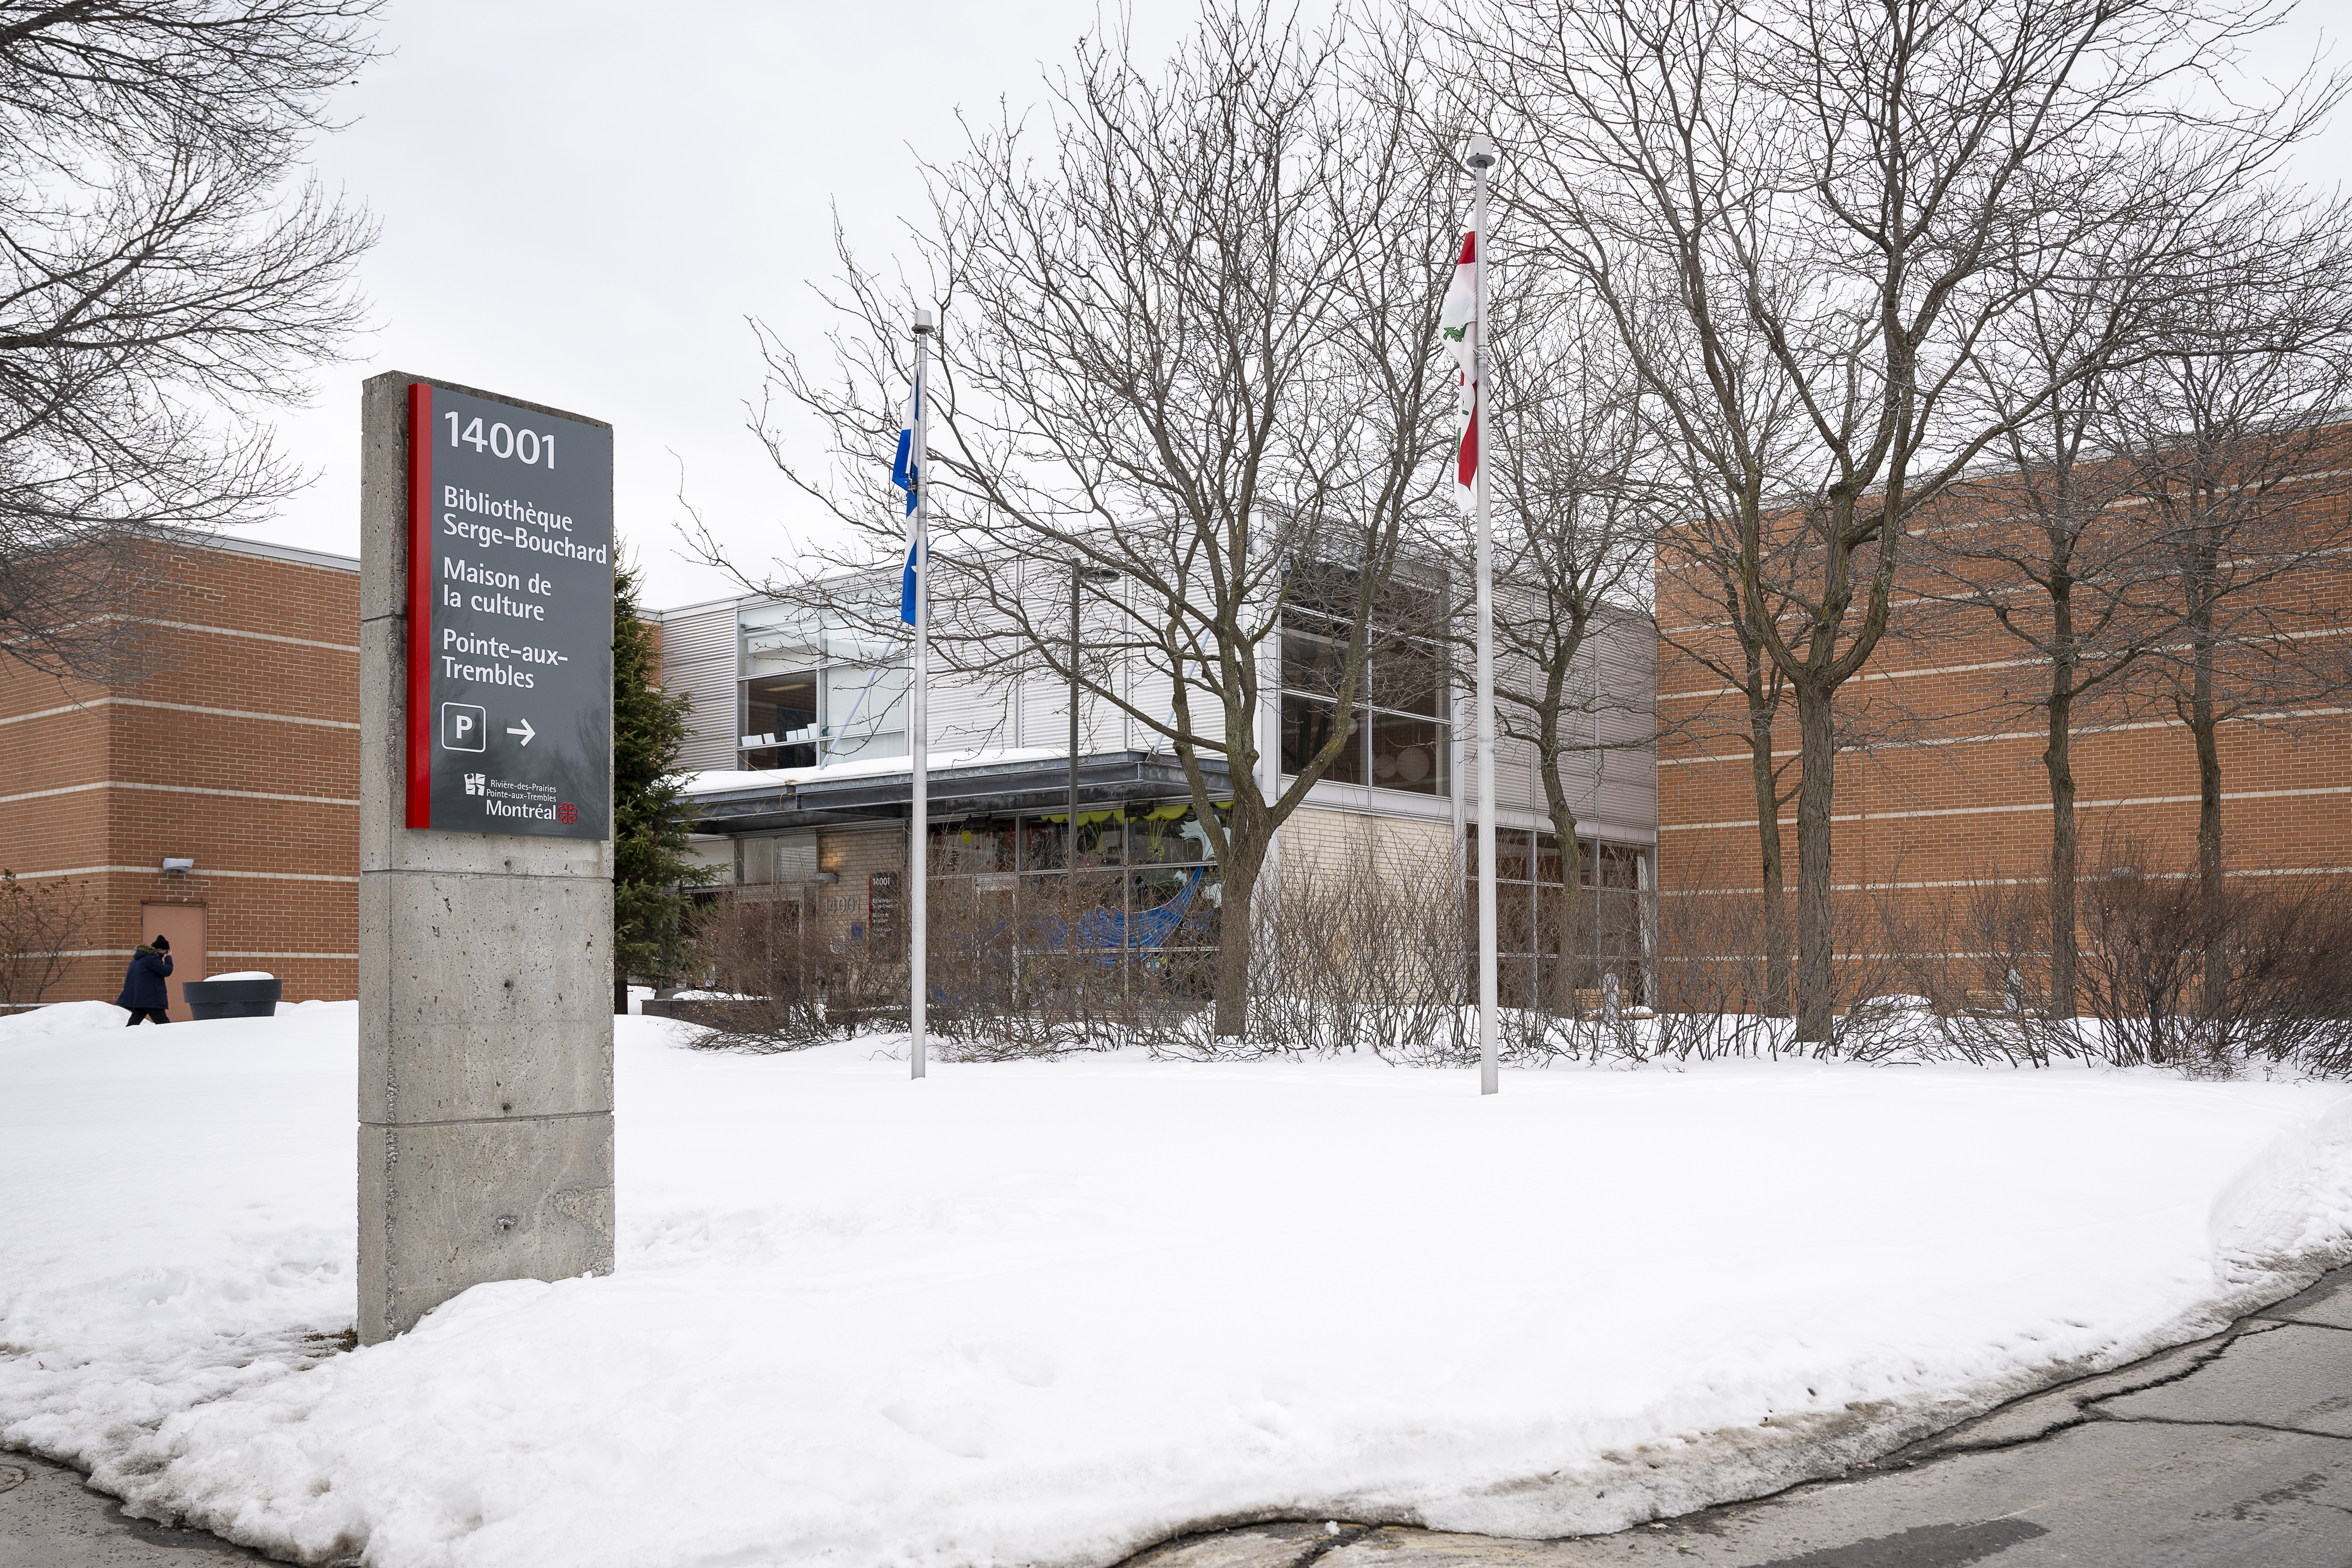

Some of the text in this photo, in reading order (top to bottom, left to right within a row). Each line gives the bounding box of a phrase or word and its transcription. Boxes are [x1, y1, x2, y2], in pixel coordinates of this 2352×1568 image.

[445, 411, 554, 469] 14001
[445, 485, 573, 533] Bibliothèque
[444, 513, 606, 564] Serge-Bouchard
[444, 557, 552, 596] Maison de
[444, 584, 544, 621] la culture
[444, 628, 568, 666] Pointe-aux-
[441, 655, 534, 689] Trembles
[456, 715, 473, 739] P
[486, 789, 557, 802] Pointe-aux-Trembles
[490, 779, 557, 793] Rivière-des-Prairies
[486, 799, 557, 820] Montréal
[873, 877, 890, 885] 14001
[823, 897, 860, 913] 14001
